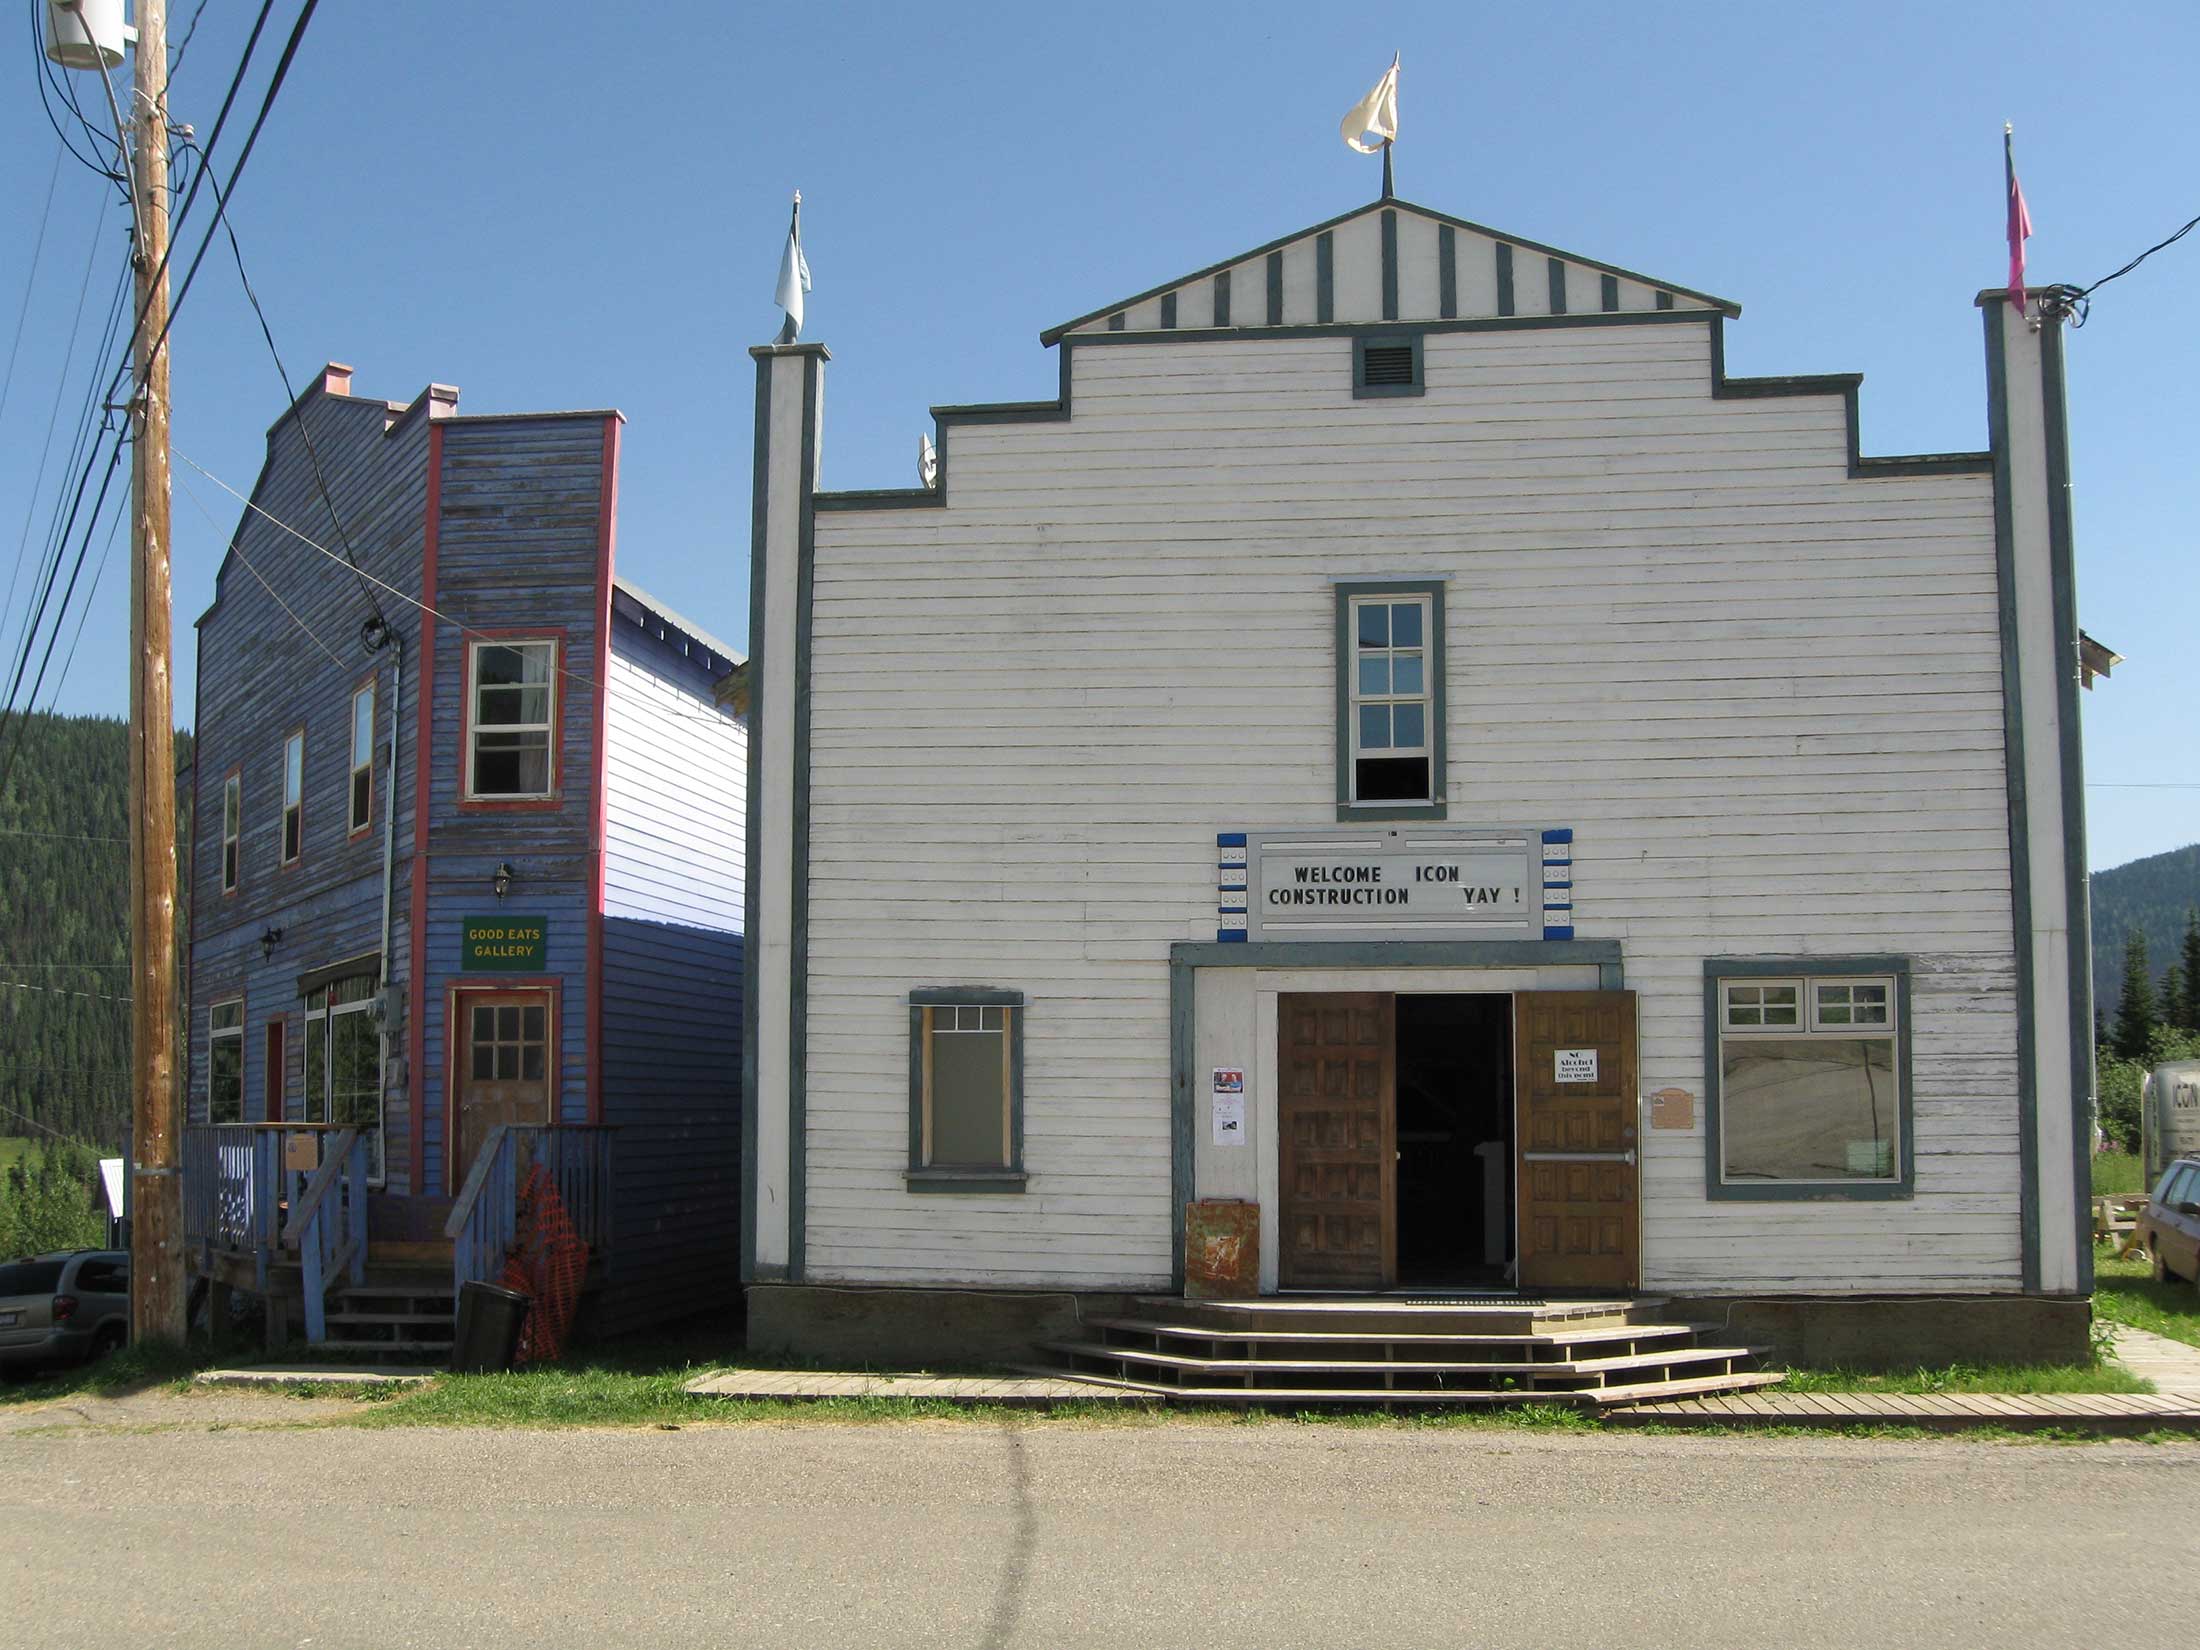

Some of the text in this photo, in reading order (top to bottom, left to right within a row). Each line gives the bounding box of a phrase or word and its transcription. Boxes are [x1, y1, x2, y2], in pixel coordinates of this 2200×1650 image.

[1294, 865, 1459, 883] WELCOME ICON
[1268, 888, 1409, 905] CONSTRUCTION
[1463, 887, 1501, 904] YAY
[469, 928, 541, 940] GOOD EATS
[474, 945, 534, 957] GALLERY
[2172, 1083, 2198, 1108] ICON
